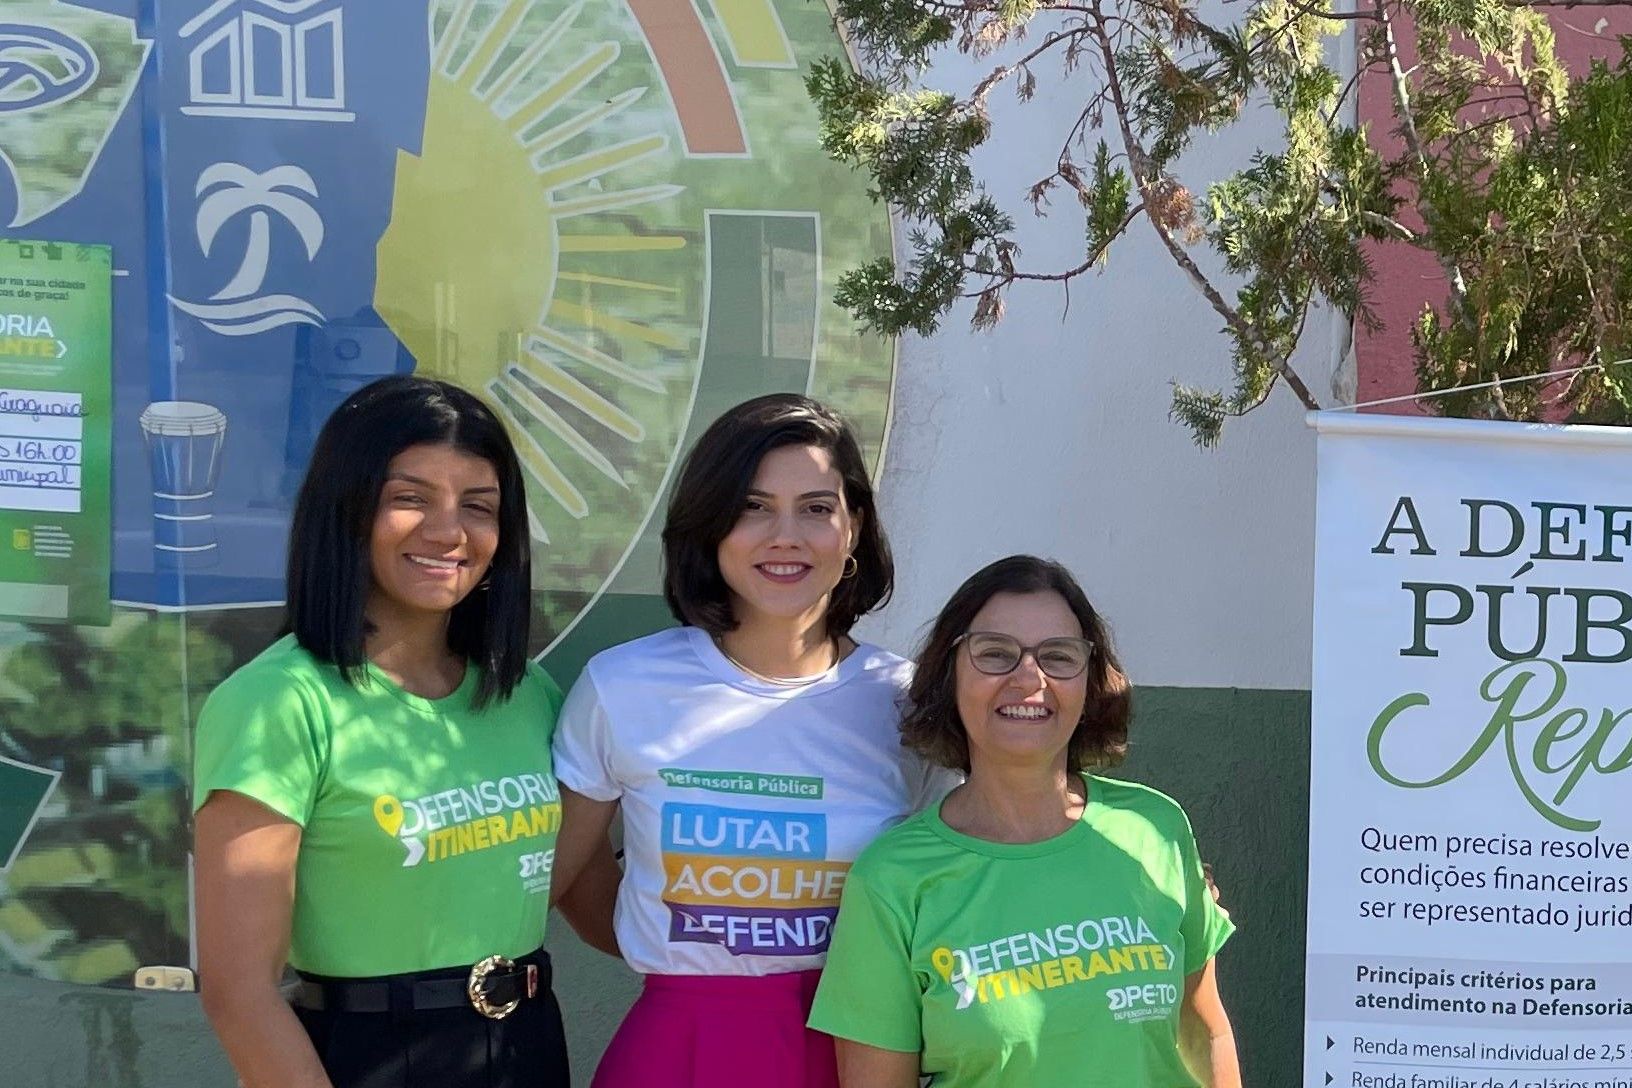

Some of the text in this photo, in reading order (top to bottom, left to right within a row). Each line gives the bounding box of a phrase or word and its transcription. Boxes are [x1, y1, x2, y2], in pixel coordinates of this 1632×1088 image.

[1371, 496, 1436, 555] A
[758, 778, 818, 796] Pública
[427, 803, 561, 863] ITINERANT
[672, 812, 811, 853] LUTAR
[1361, 827, 1437, 853] Quem
[1446, 834, 1533, 858] precisa
[670, 863, 850, 900] ACOLHE
[1360, 863, 1487, 892] condições
[1493, 866, 1629, 894] financeiras
[1359, 900, 1396, 919] ser
[1404, 902, 1570, 927] representado
[951, 915, 1159, 982] DEFENSORIA
[977, 944, 1169, 1004] ITINERANTE
[1356, 965, 1597, 995] Principais critérios para
[1355, 992, 1487, 1015] atendimento
[1492, 999, 1517, 1016] na
[1353, 1036, 1408, 1056] Renda
[1413, 1042, 1475, 1059] mensal
[1481, 1043, 1568, 1061] individual
[1573, 1044, 1596, 1061] de
[1600, 1043, 1626, 1063] 2,5
